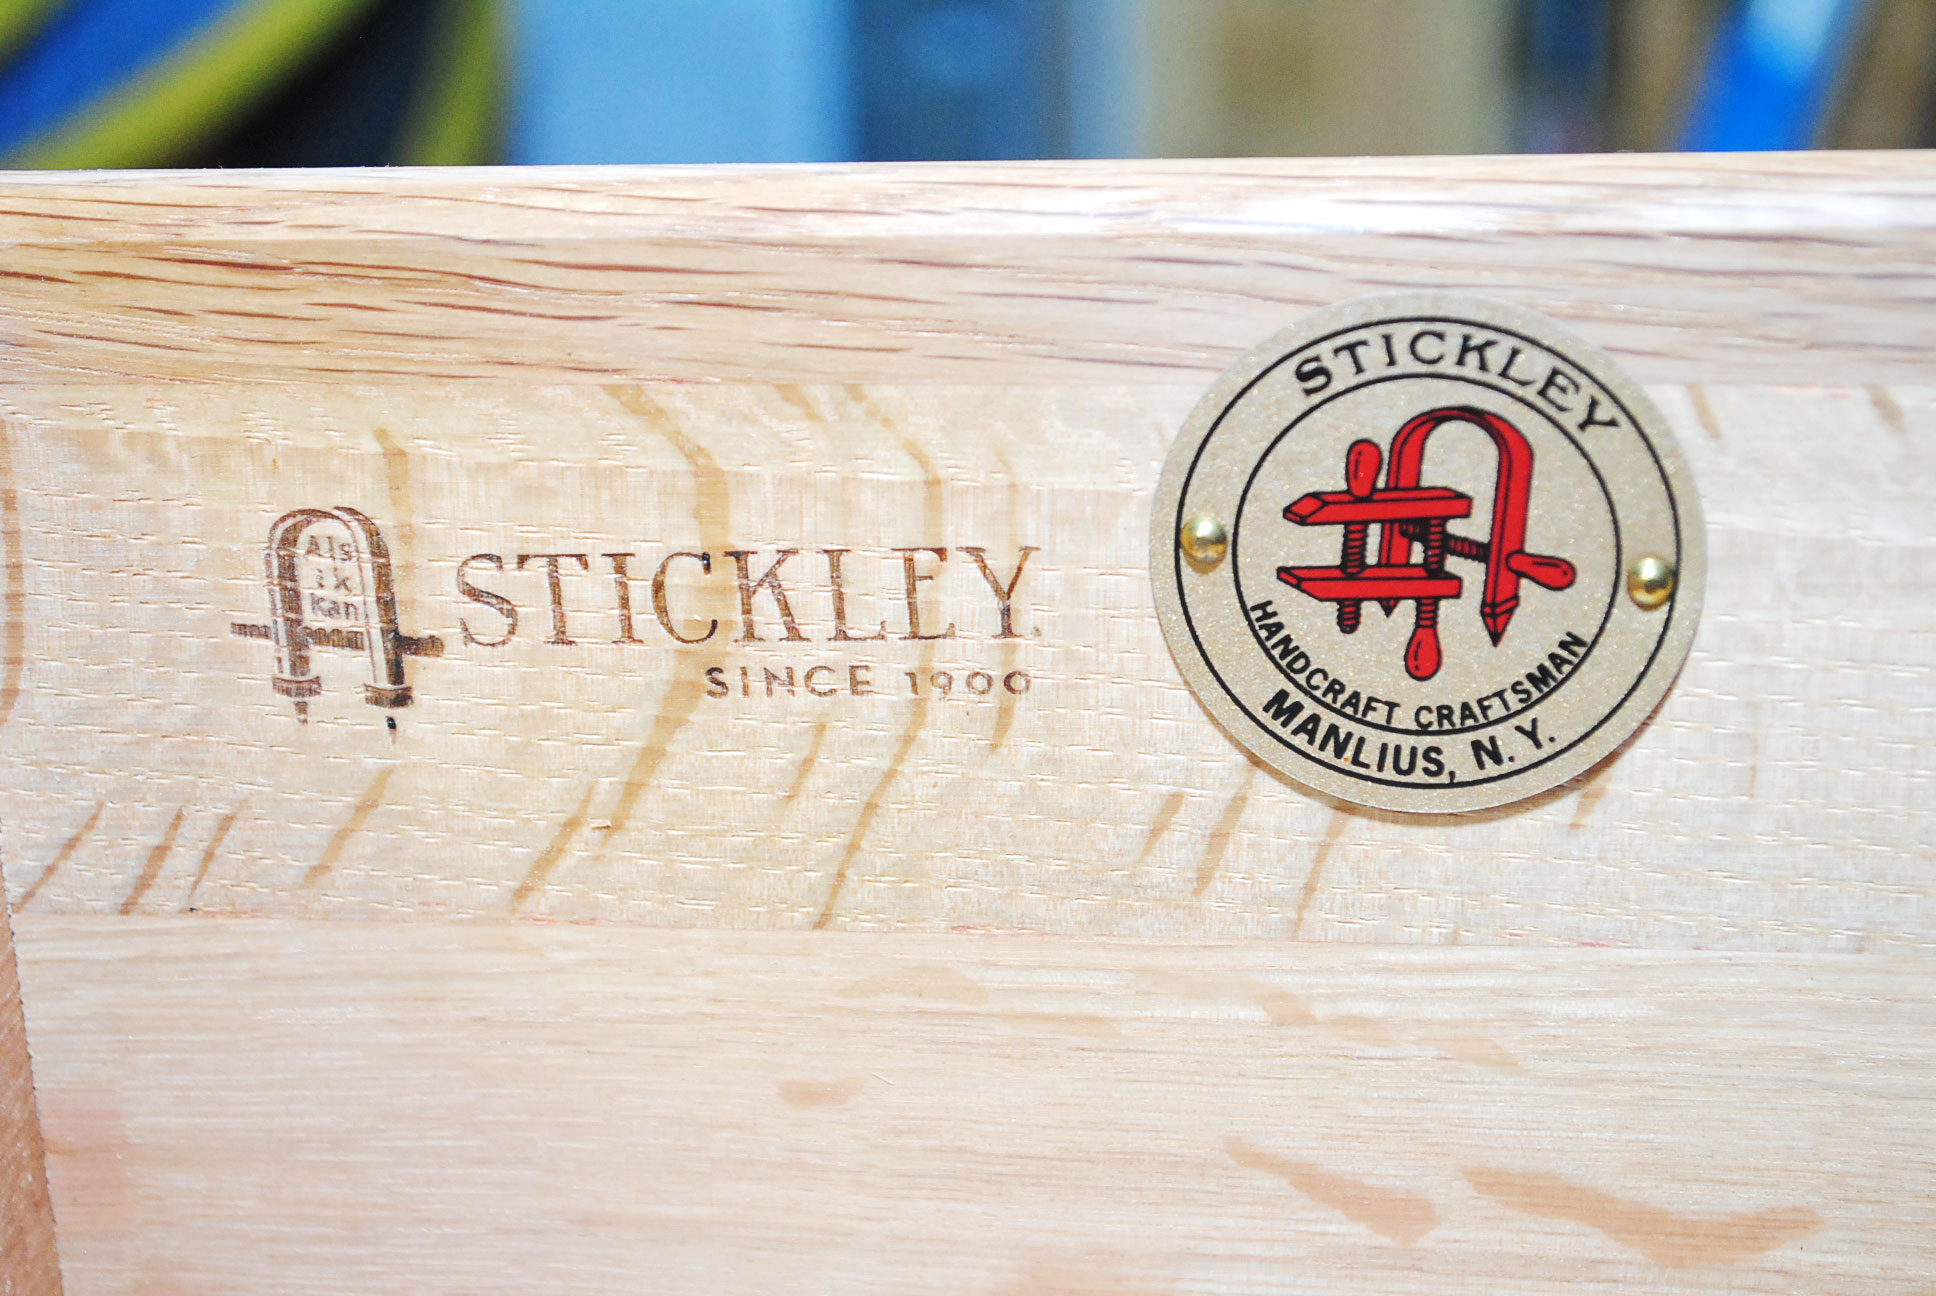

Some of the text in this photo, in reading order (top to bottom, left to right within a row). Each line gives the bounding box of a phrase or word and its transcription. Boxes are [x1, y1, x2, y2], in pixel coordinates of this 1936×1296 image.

[1294, 330, 1621, 432] STICKLEY
[705, 664, 1032, 699] SINCE 1900
[1249, 599, 1589, 730] HANDCRAFT CRAFTSMAN
[1262, 689, 1457, 783] MANLIUS,
